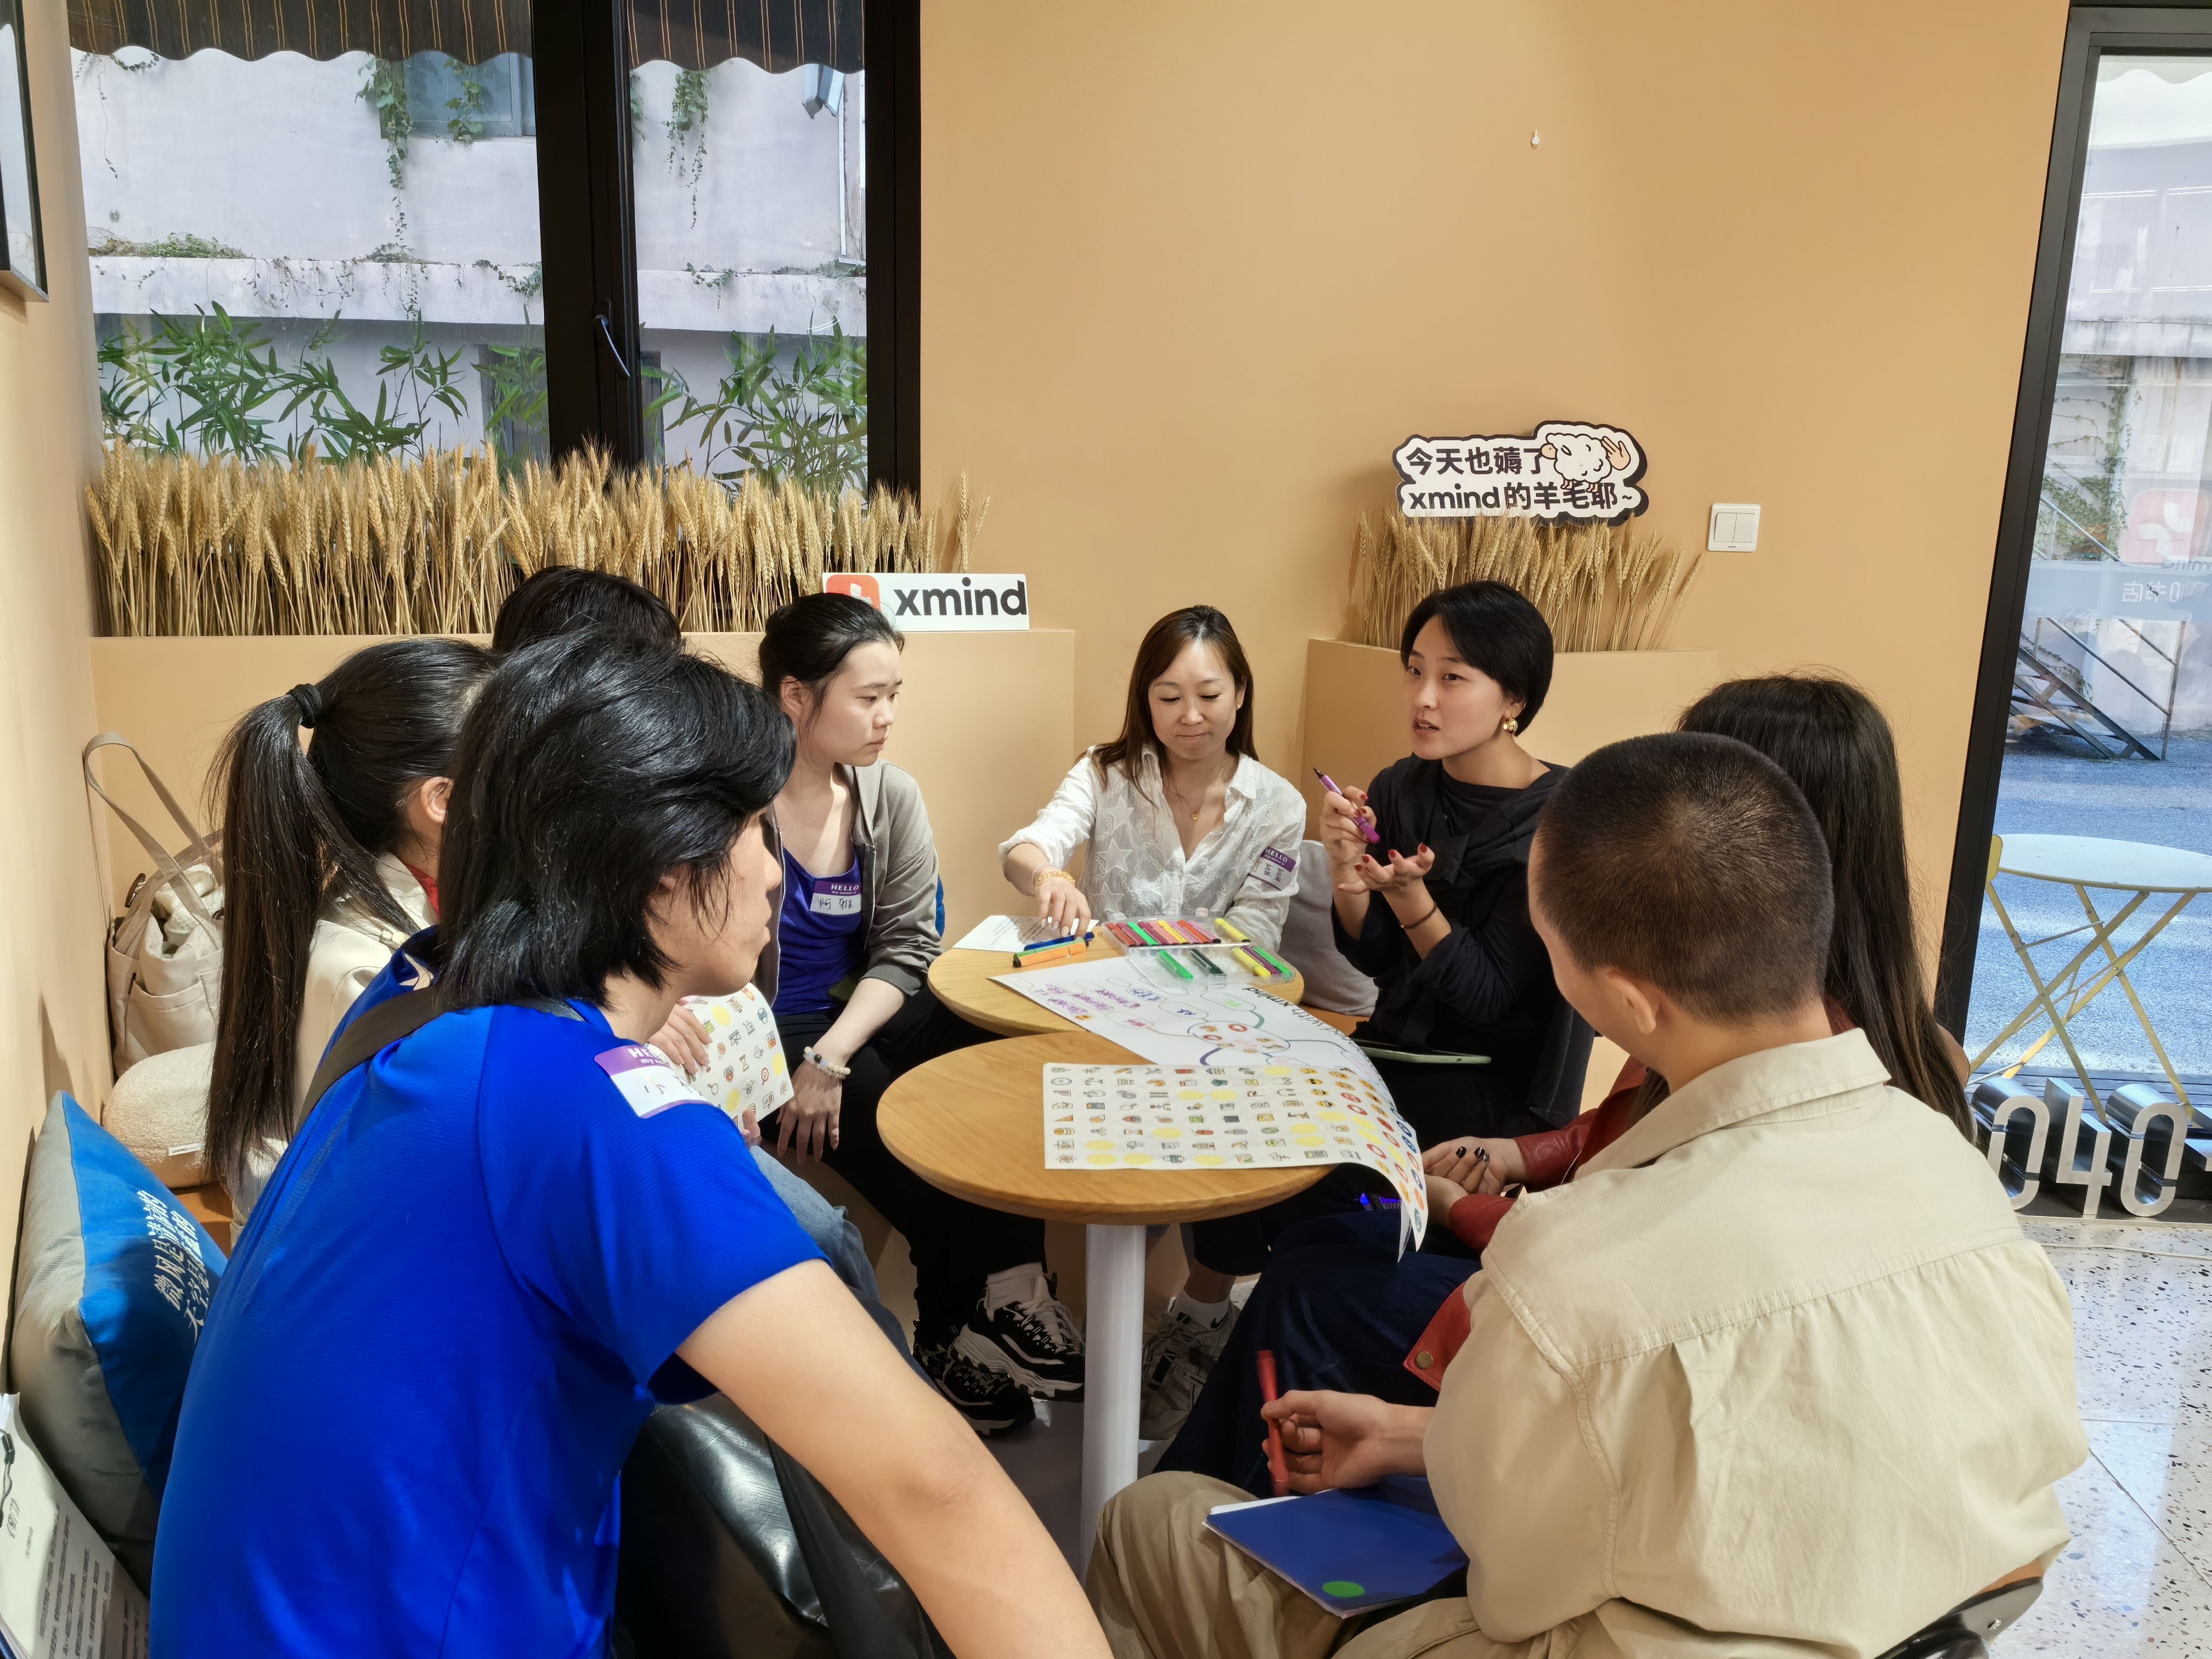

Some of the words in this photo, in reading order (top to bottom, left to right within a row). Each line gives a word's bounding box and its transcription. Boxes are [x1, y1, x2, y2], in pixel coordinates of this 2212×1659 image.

[1406, 447, 1543, 476] 今天也薅了
[893, 576, 1027, 616] xmind
[1265, 848, 1287, 862] HELLO
[831, 884, 859, 892] HELLO
[1242, 987, 1294, 1008] xmind
